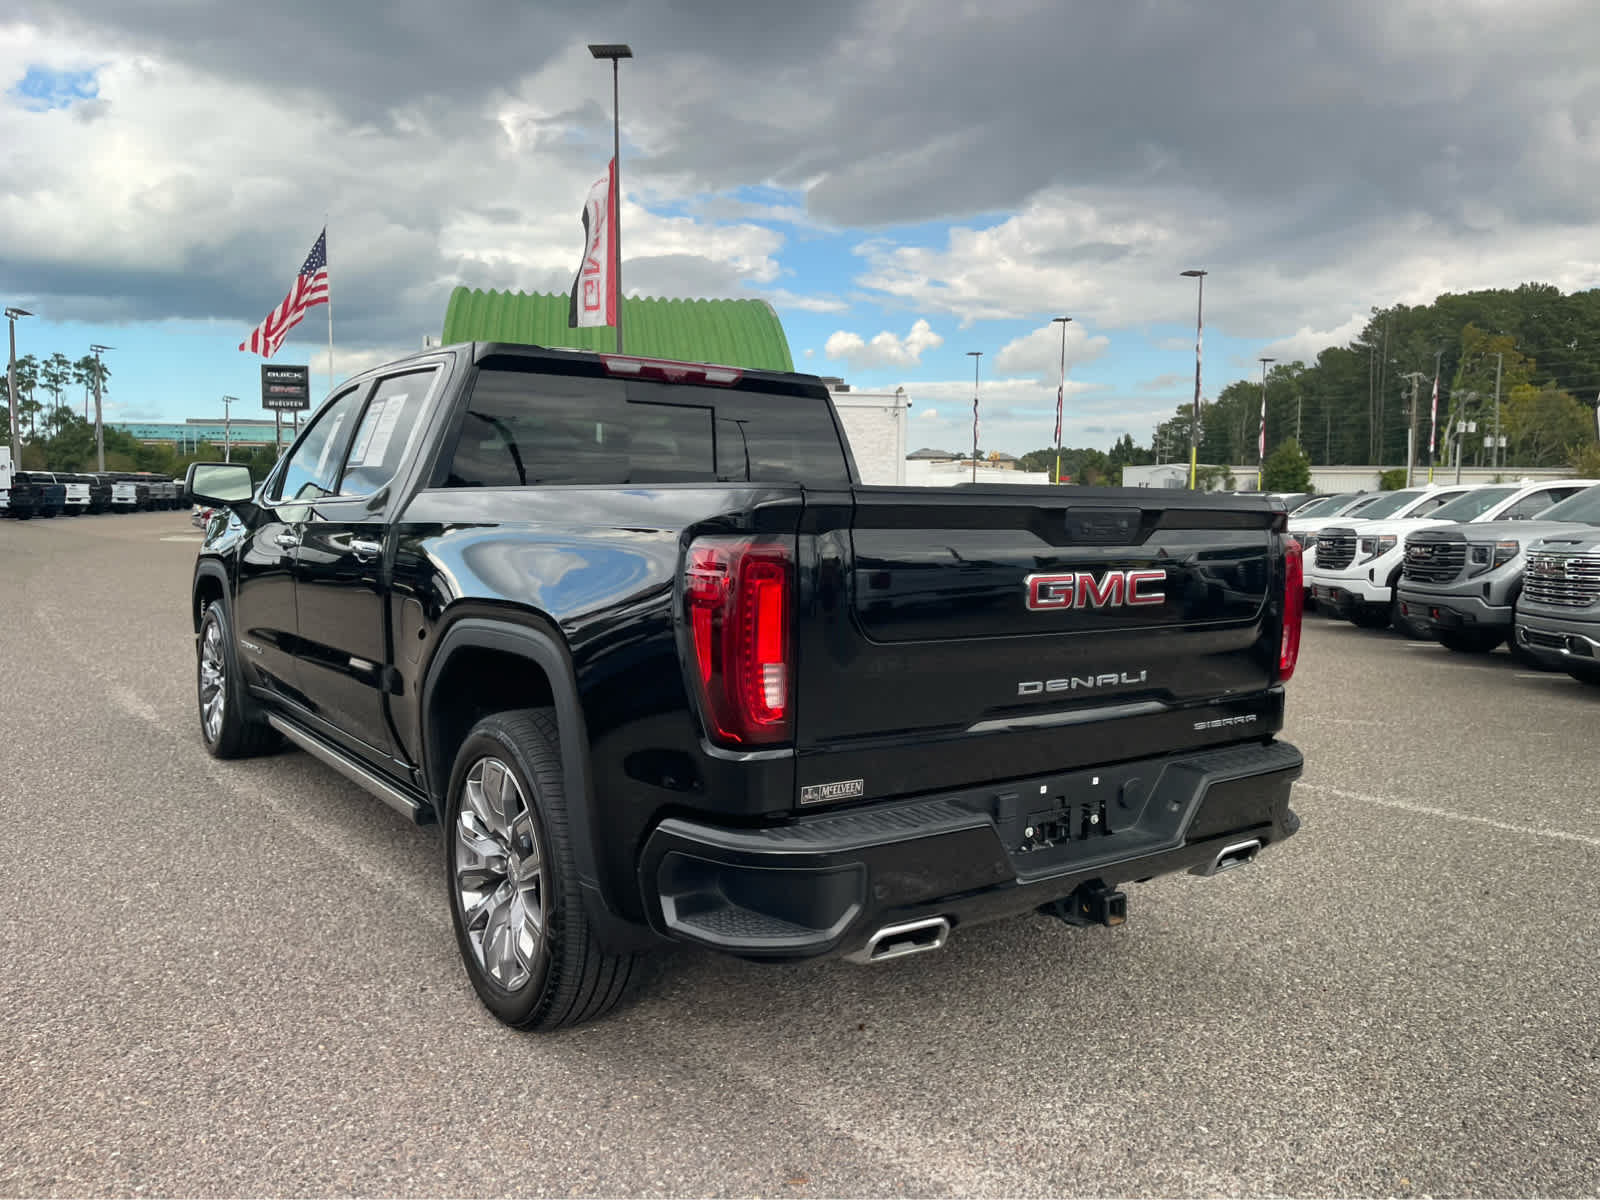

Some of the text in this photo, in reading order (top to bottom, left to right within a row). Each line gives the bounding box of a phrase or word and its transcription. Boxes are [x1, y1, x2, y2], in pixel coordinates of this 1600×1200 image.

[1024, 569, 1166, 611] GMC
[1018, 670, 1147, 696] DENALI
[1193, 714, 1257, 730] SIERRA
